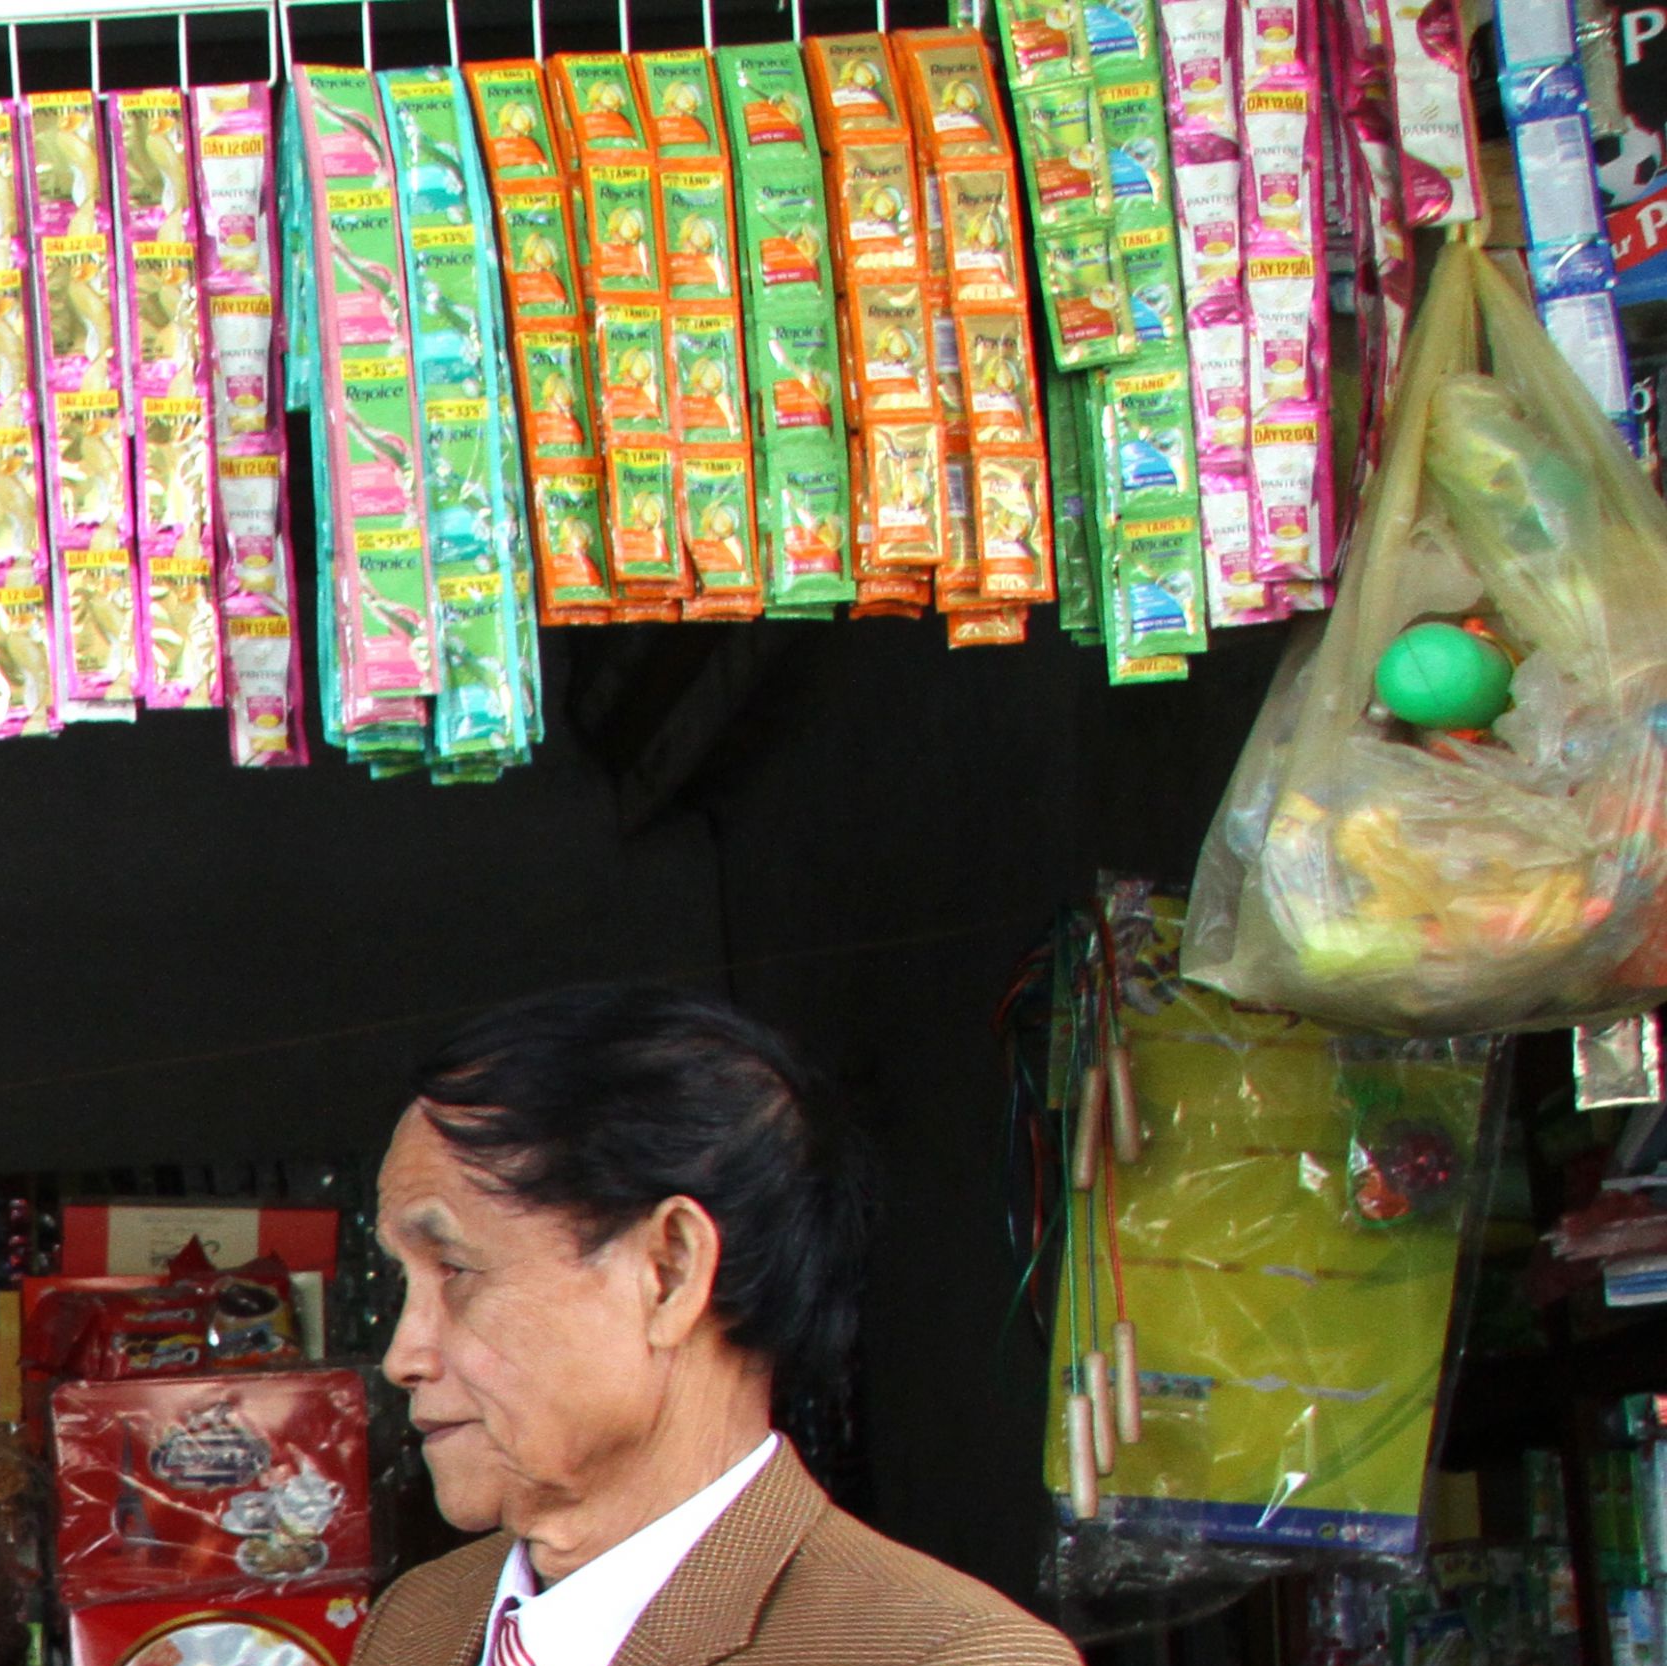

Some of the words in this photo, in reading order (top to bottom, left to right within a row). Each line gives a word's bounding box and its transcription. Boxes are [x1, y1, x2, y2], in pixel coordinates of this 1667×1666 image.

[740, 58, 788, 70] Rejoice
[931, 63, 977, 75] Rejoice
[487, 86, 533, 98] Rejoice
[1402, 123, 1461, 138] PANTENE
[227, 138, 241, 153] 12
[331, 217, 387, 233] Rejoice
[415, 252, 472, 267] Rejoice
[868, 305, 916, 318] Rejoice
[346, 385, 404, 401] Rejoice
[1281, 427, 1293, 441] 12
[1131, 535, 1183, 552] Rejoice
